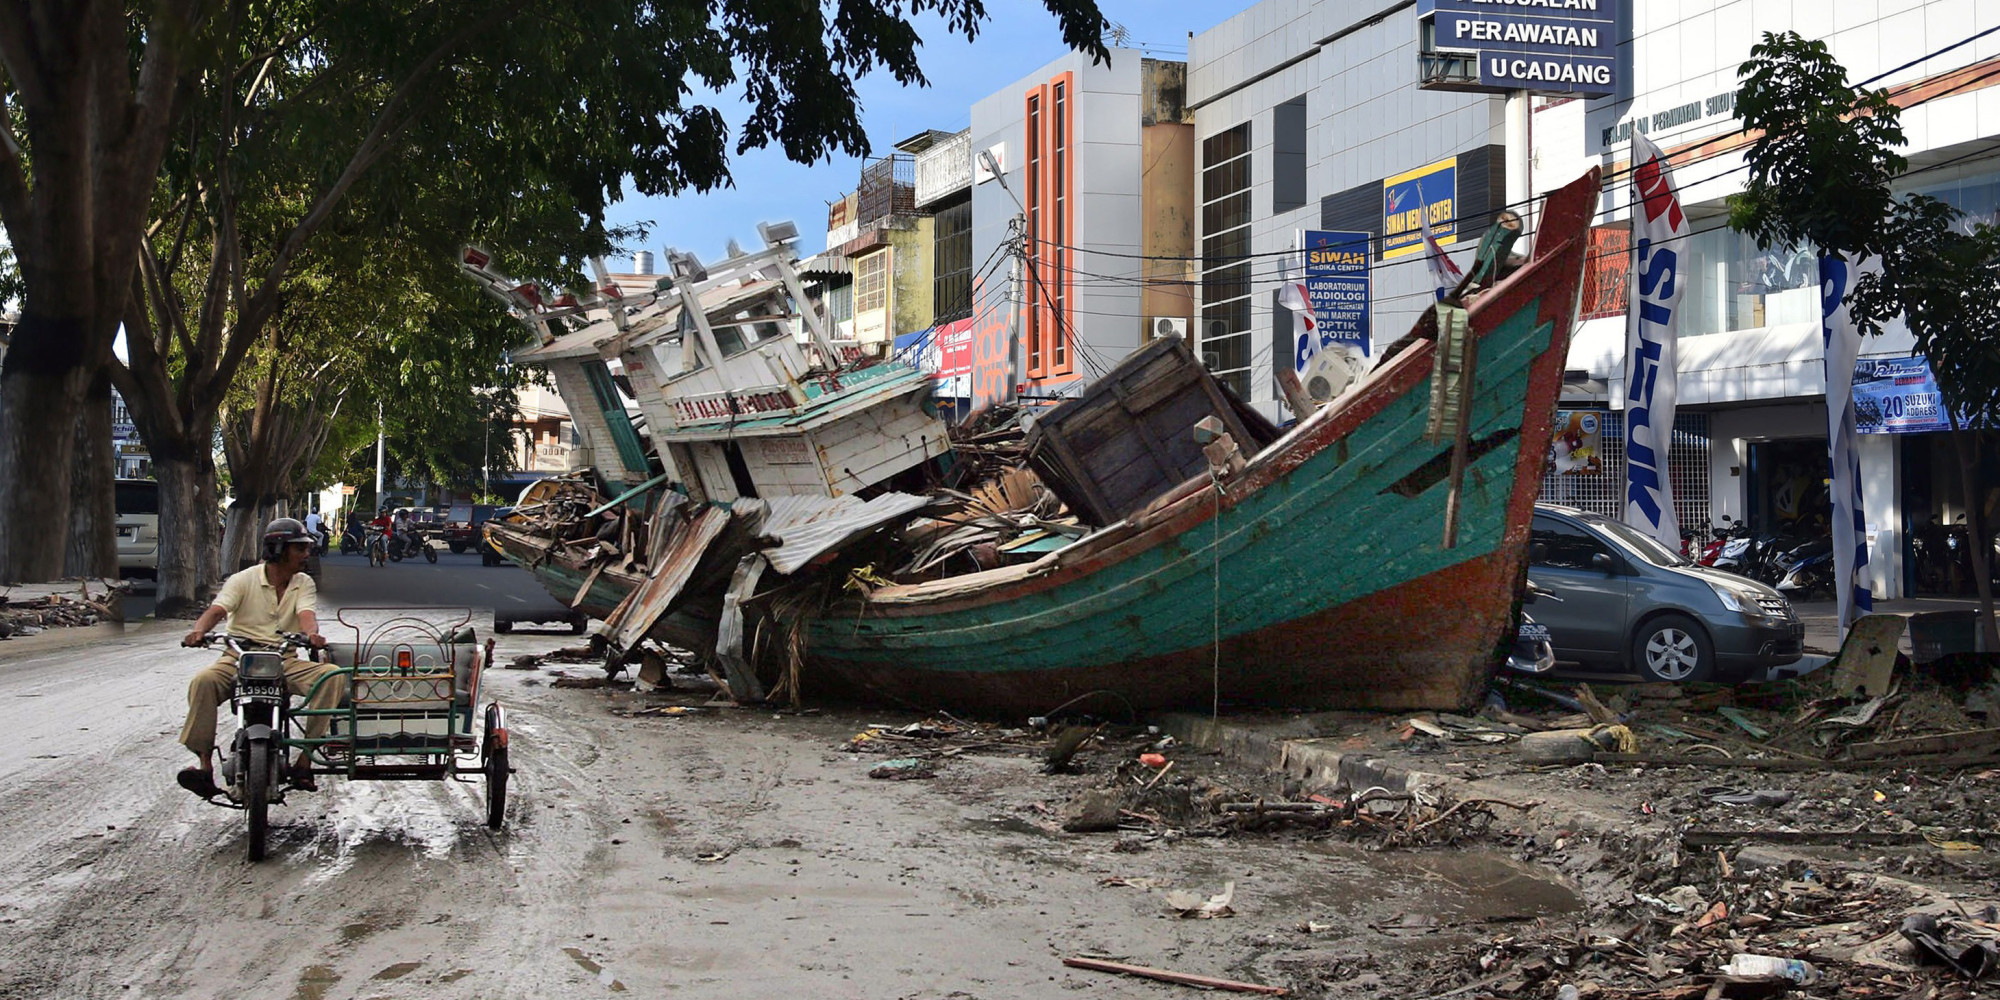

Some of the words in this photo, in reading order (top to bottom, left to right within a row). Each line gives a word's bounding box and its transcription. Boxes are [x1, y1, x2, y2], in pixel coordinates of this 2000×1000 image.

[1455, 19, 1597, 47] PERAWATAN
[1510, 60, 1611, 84] CADANG
[1652, 101, 1702, 132] PERAWATAN
[1387, 212, 1405, 235] SIWAH
[1430, 198, 1452, 224] CENTER
[1310, 251, 1365, 264] SIWAH
[1309, 282, 1365, 291] LABORATORIUM
[1309, 291, 1365, 301] RADIOLOGI
[1331, 311, 1361, 320] MARKET
[1318, 321, 1357, 330] OPTIK
[1320, 331, 1361, 340] POTEK
[1905, 392, 1936, 406] SUZUKI
[1882, 395, 1903, 418] 20
[1906, 405, 1938, 417] ADDRESS
